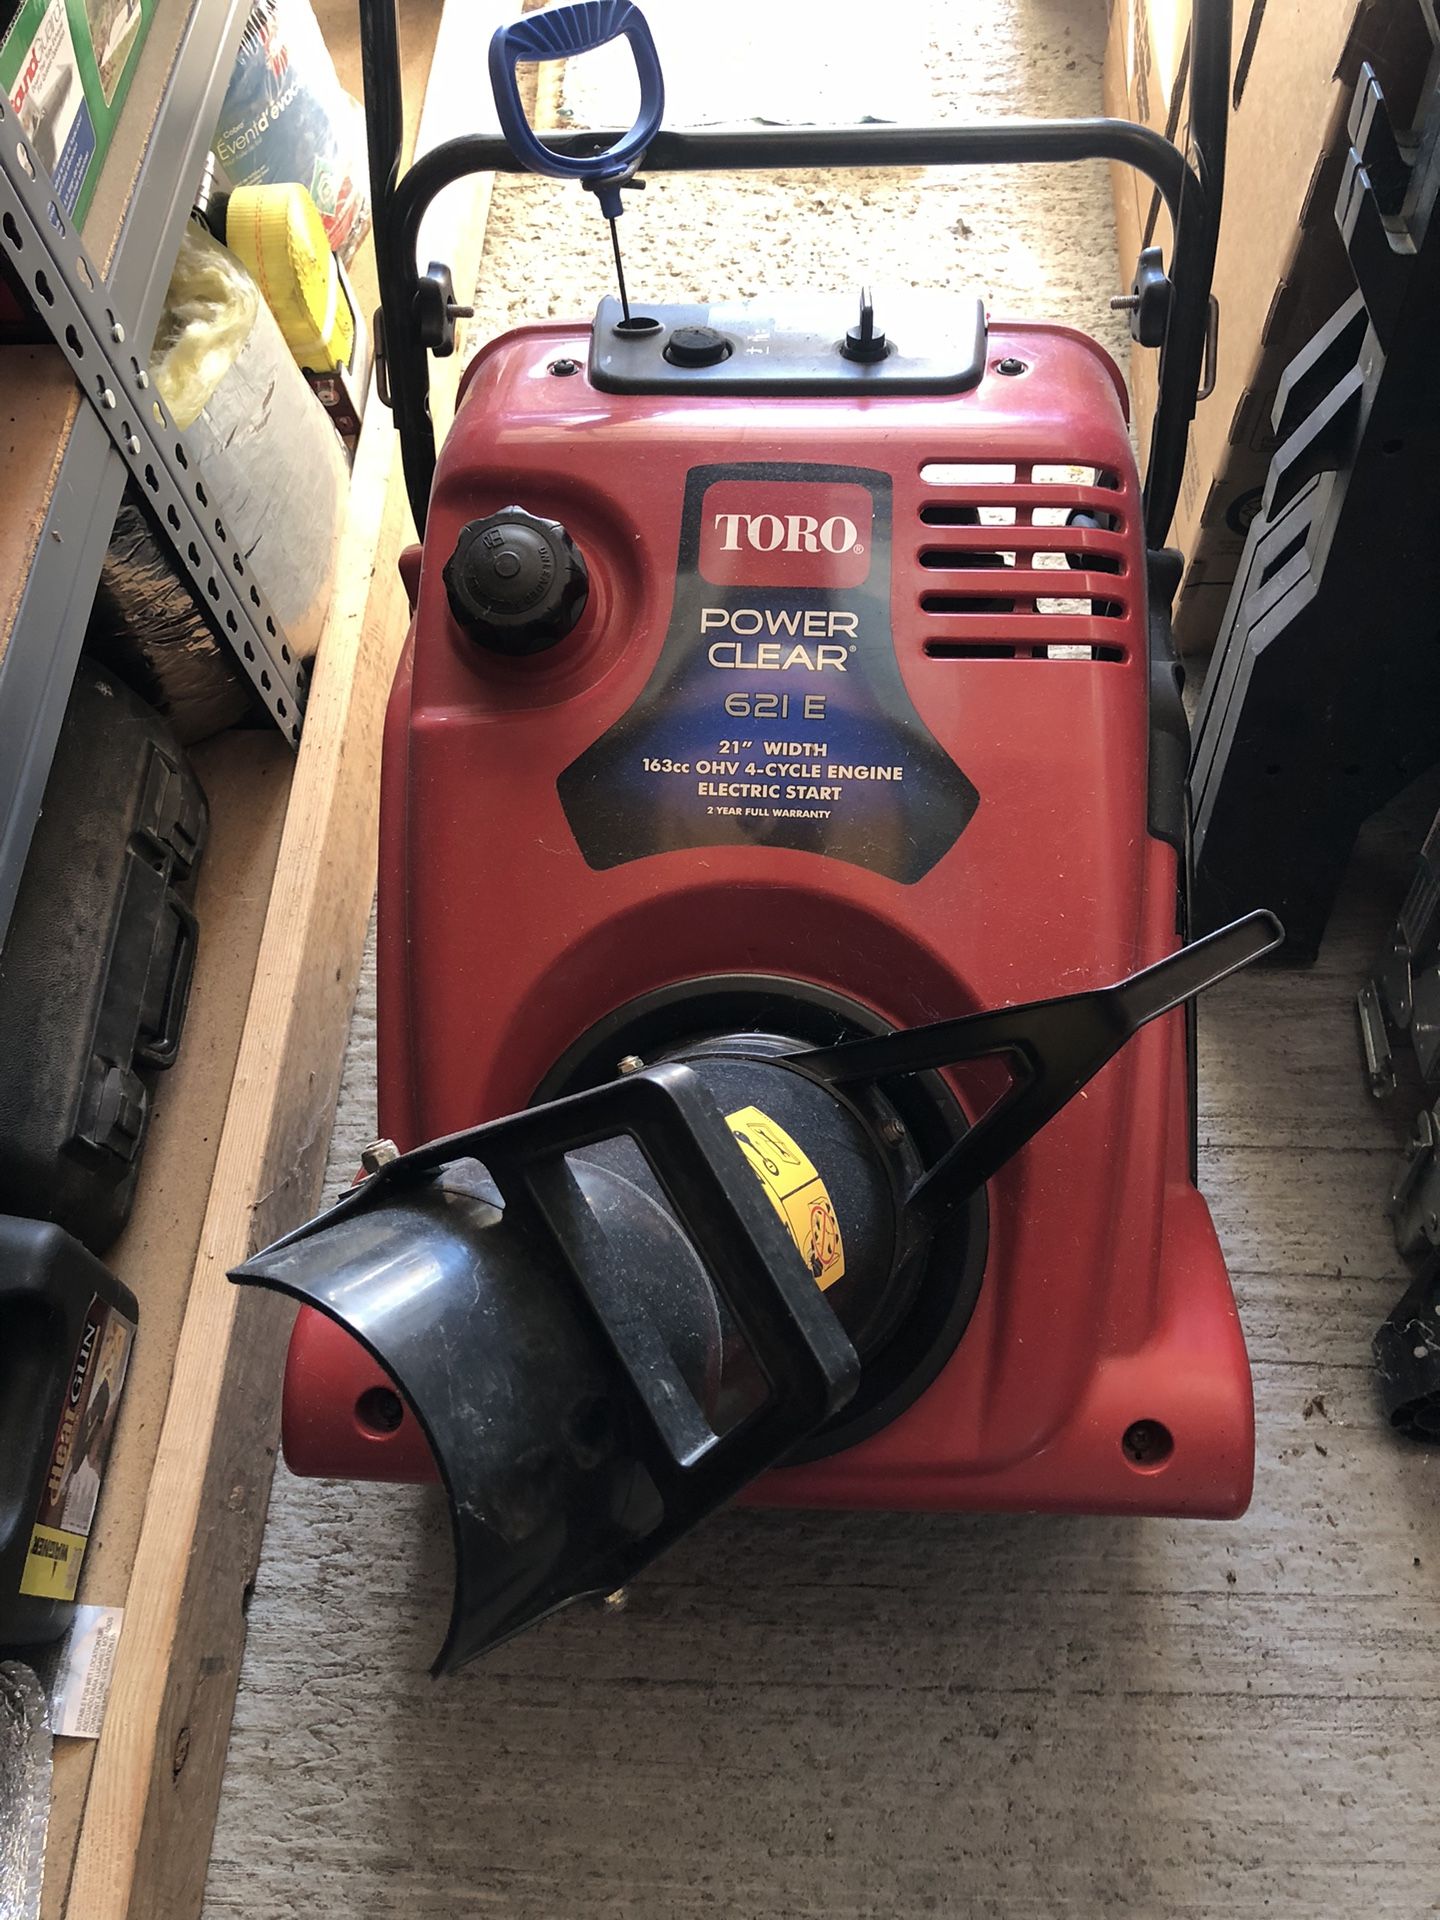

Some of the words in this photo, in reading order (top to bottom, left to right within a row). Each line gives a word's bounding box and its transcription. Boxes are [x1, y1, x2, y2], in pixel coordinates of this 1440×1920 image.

[700, 608, 859, 638] POWER
[708, 642, 848, 672] CLEAR
[724, 693, 788, 718] 621
[804, 694, 826, 719] E
[764, 741, 827, 757] WIDTH
[642, 758, 690, 773] 163cc
[696, 761, 739, 775] OHV
[744, 762, 821, 778] 4-CYCLE
[827, 765, 903, 781] ENGINE
[698, 782, 780, 798] ELECTRIC
[786, 786, 842, 800] START
[707, 806, 714, 815] 2
[717, 807, 742, 816] YEAR
[745, 808, 769, 816] FULL
[772, 809, 831, 819] WARRANTY
[48, 1407, 76, 1491] Heat
[70, 1323, 96, 1402] GUN
